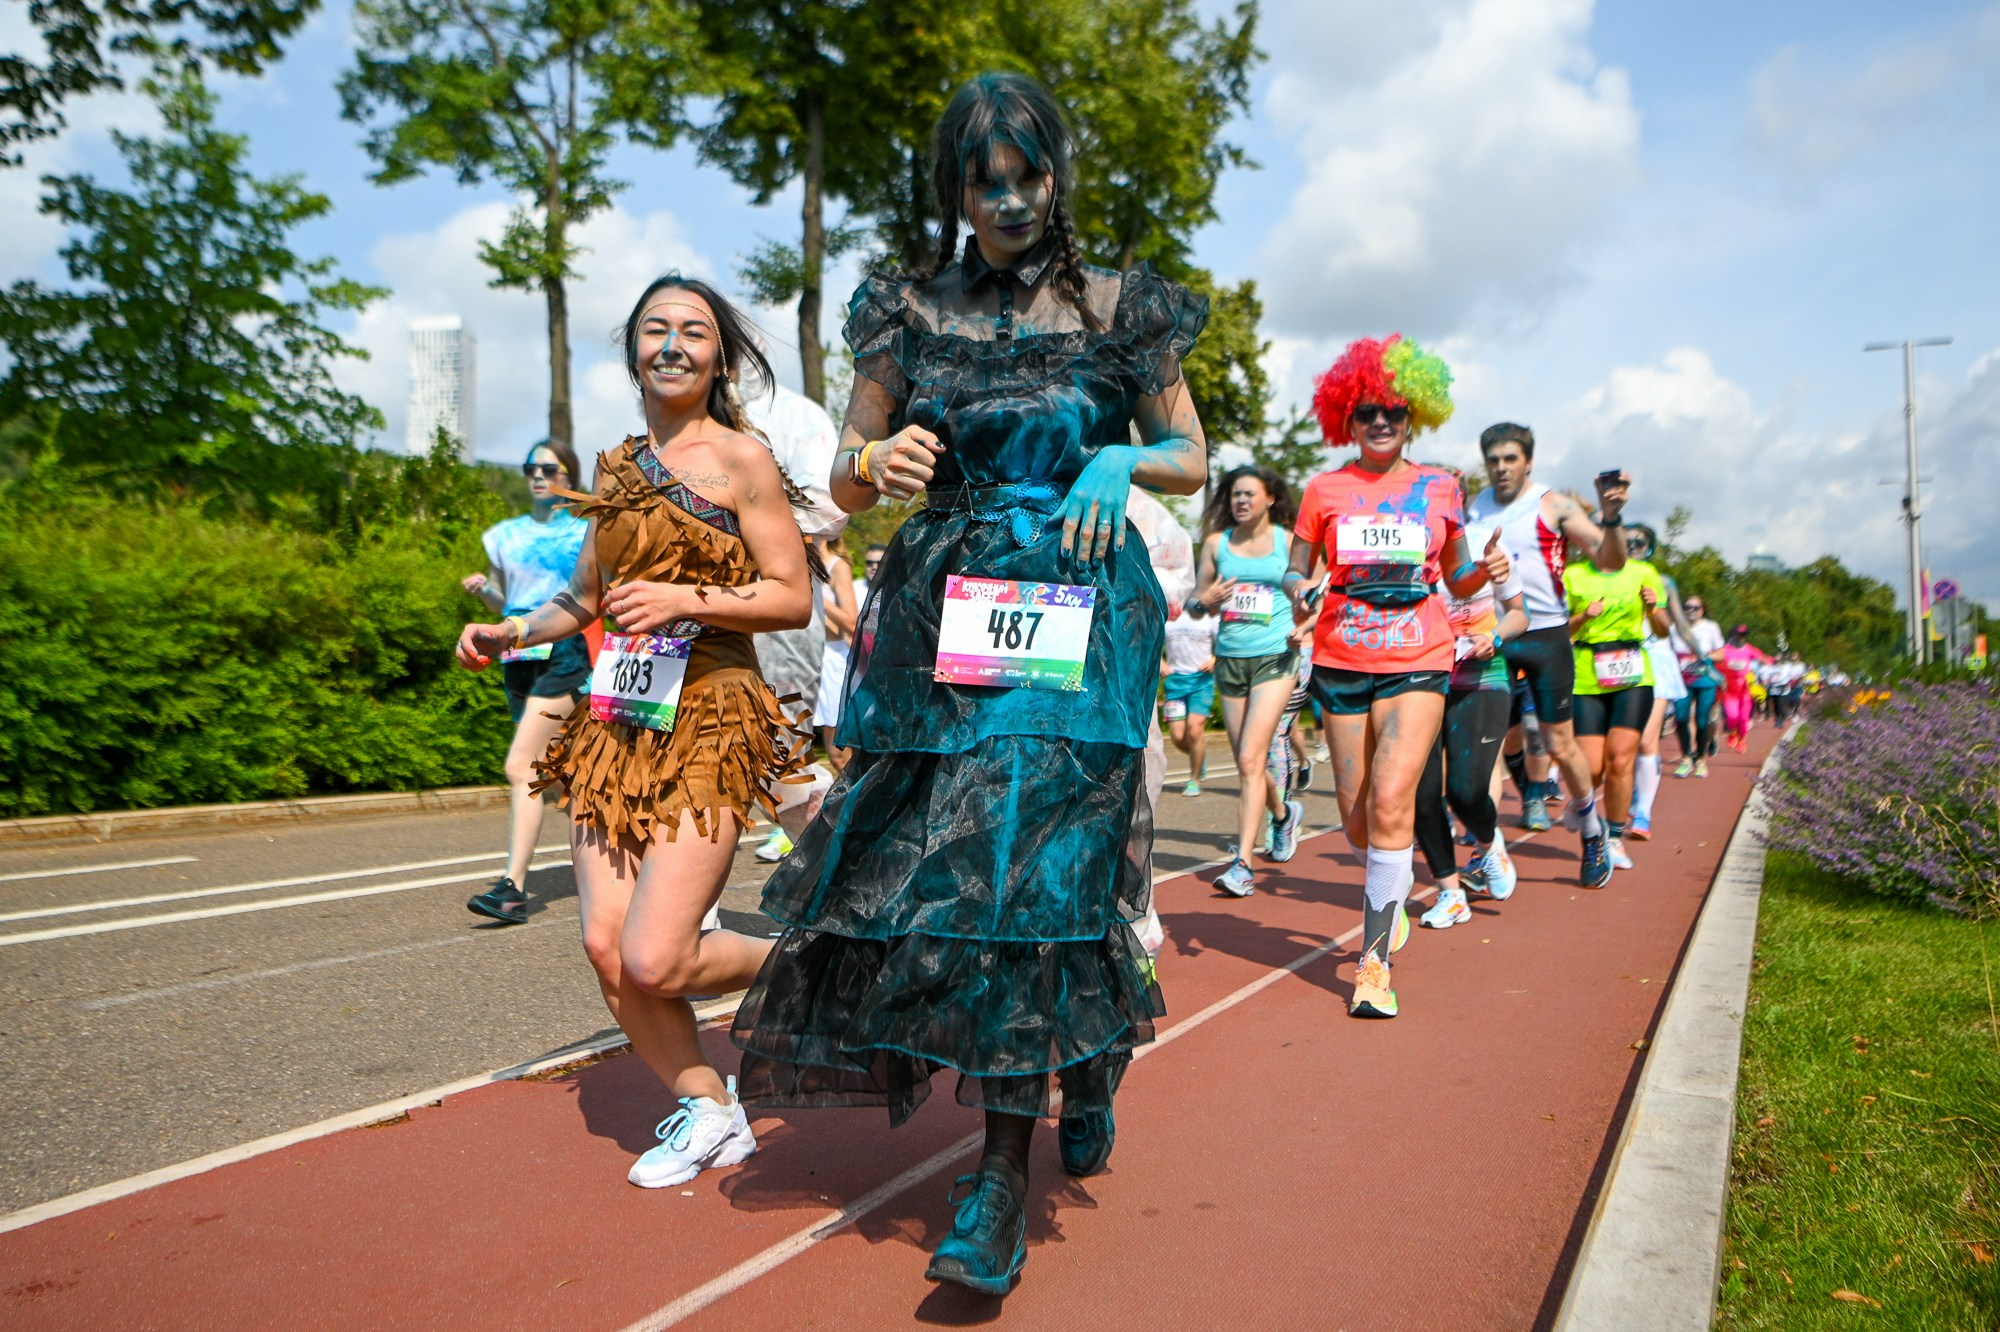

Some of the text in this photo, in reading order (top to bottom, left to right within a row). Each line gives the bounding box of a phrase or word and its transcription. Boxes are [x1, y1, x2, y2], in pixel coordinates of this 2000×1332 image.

[1361, 528, 1401, 546] 1345
[1235, 595, 1256, 610] 1691
[987, 609, 1045, 650] 487
[1343, 626, 1403, 650] ФОН
[612, 658, 654, 695] 1693
